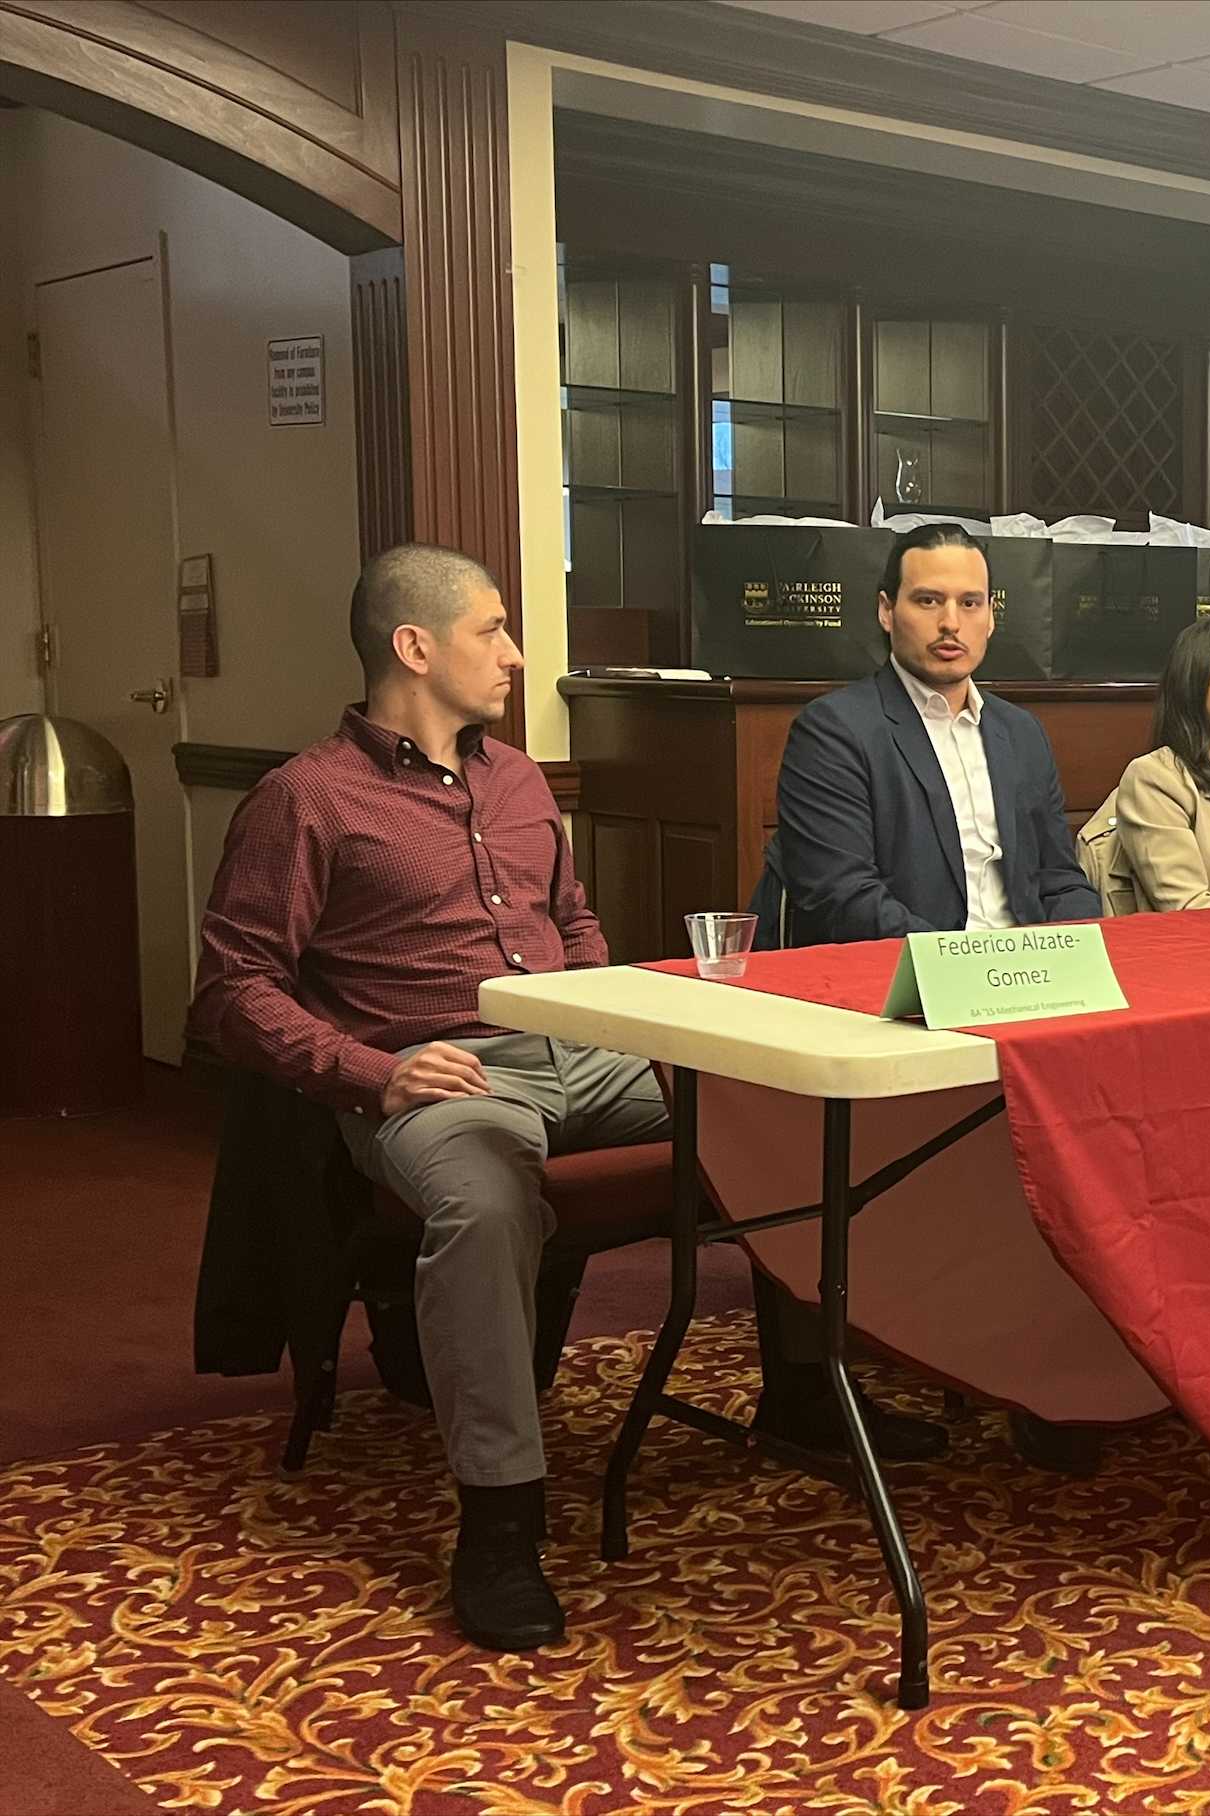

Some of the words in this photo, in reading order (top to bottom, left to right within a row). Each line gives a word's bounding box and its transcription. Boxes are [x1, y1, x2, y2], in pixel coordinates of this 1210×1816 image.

[937, 933, 1017, 956] Federico
[1022, 931, 1081, 951] Alzate-
[986, 968, 1051, 988] Gomez
